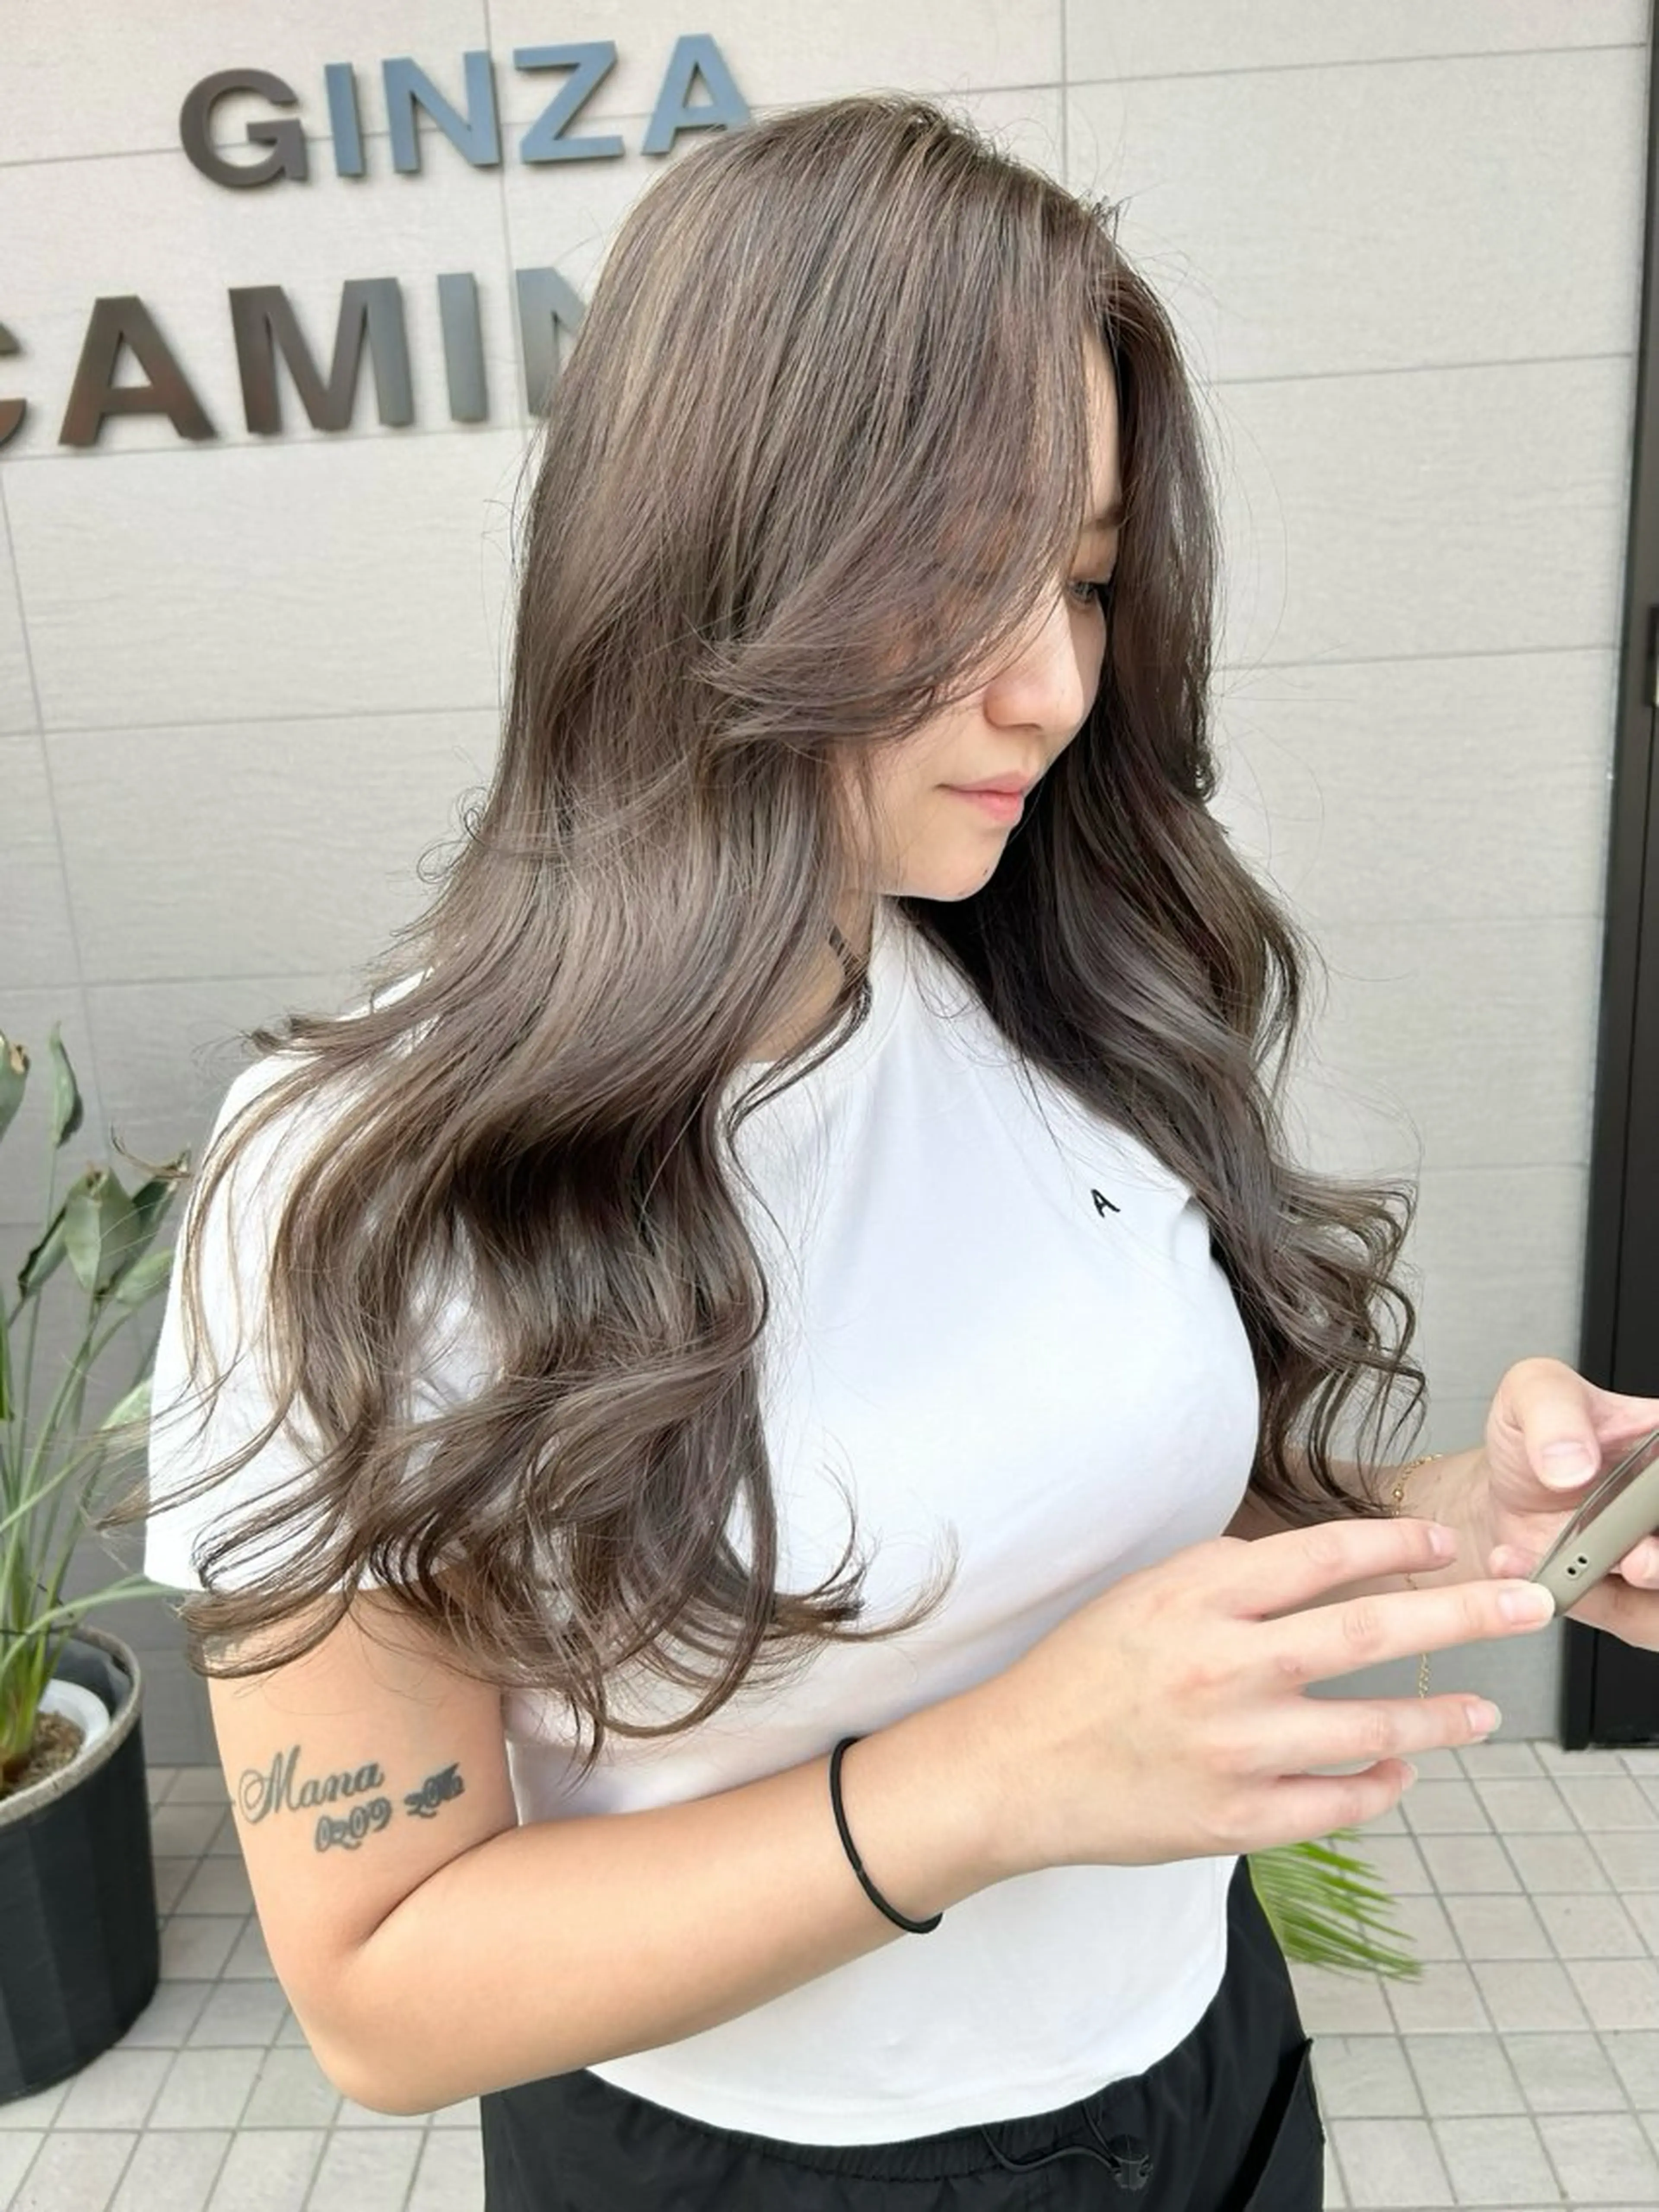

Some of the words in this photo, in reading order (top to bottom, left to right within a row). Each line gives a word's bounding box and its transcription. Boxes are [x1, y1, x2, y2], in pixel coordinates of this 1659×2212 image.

[180, 33, 750, 189] GINZA
[0, 267, 587, 450] AMIN
[238, 1745, 385, 1824] Mana
